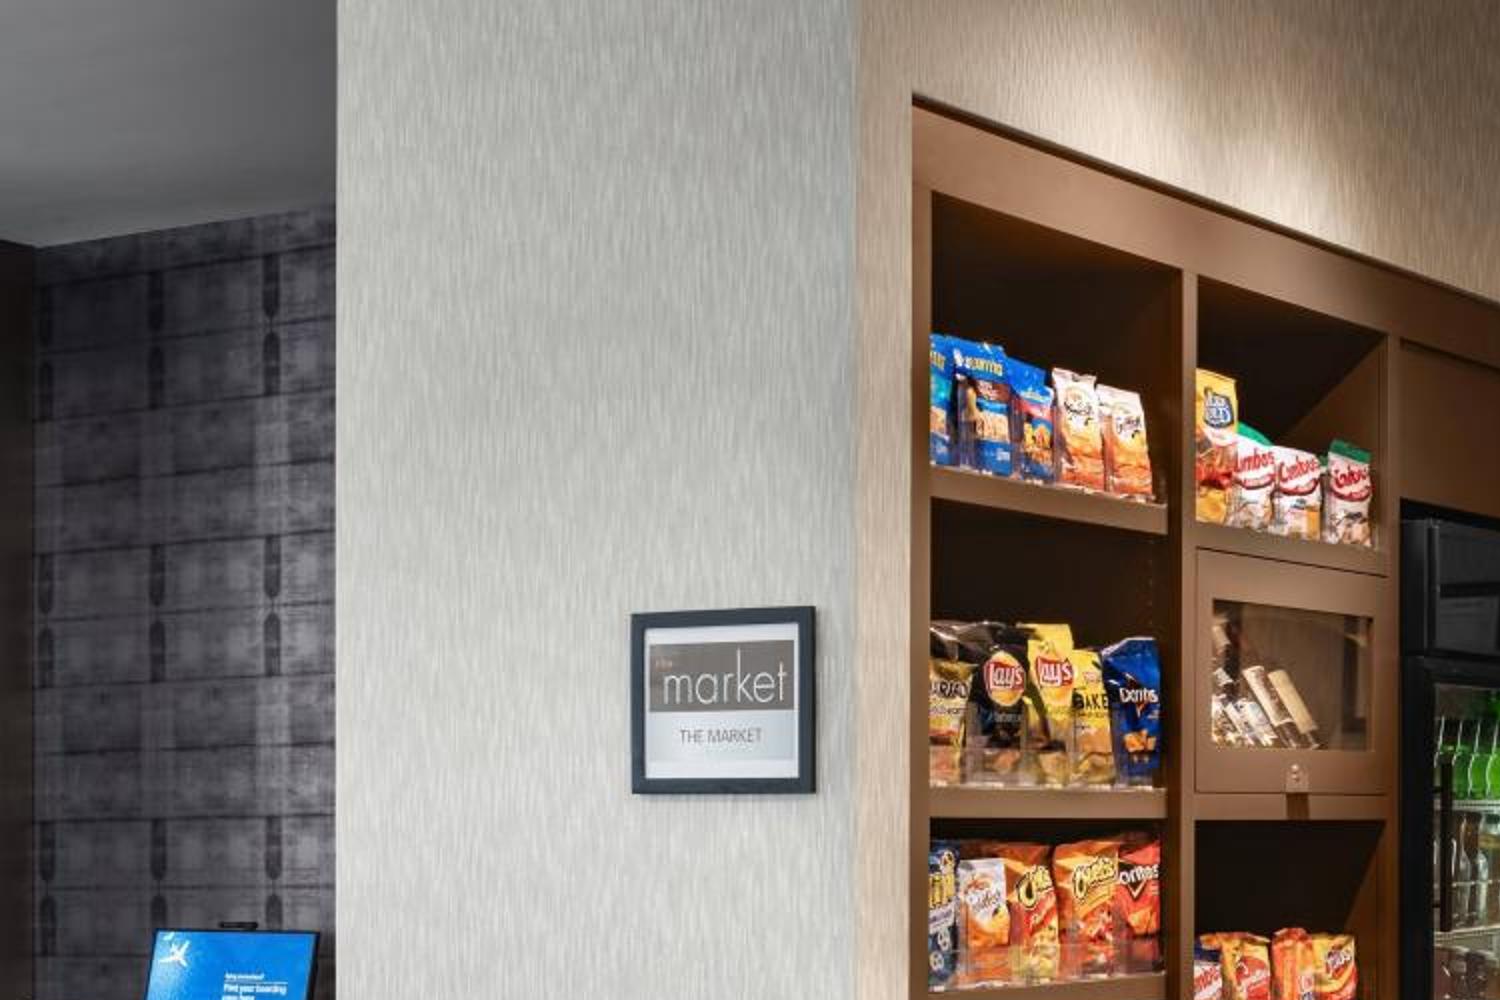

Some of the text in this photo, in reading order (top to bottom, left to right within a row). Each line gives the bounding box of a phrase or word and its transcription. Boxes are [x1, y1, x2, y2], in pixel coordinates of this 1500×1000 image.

[663, 647, 788, 705] market
[1073, 691, 1110, 712] BAKE
[1118, 686, 1159, 705] Doritos
[680, 727, 763, 744] THE MARKET
[1118, 863, 1160, 886] oritos
